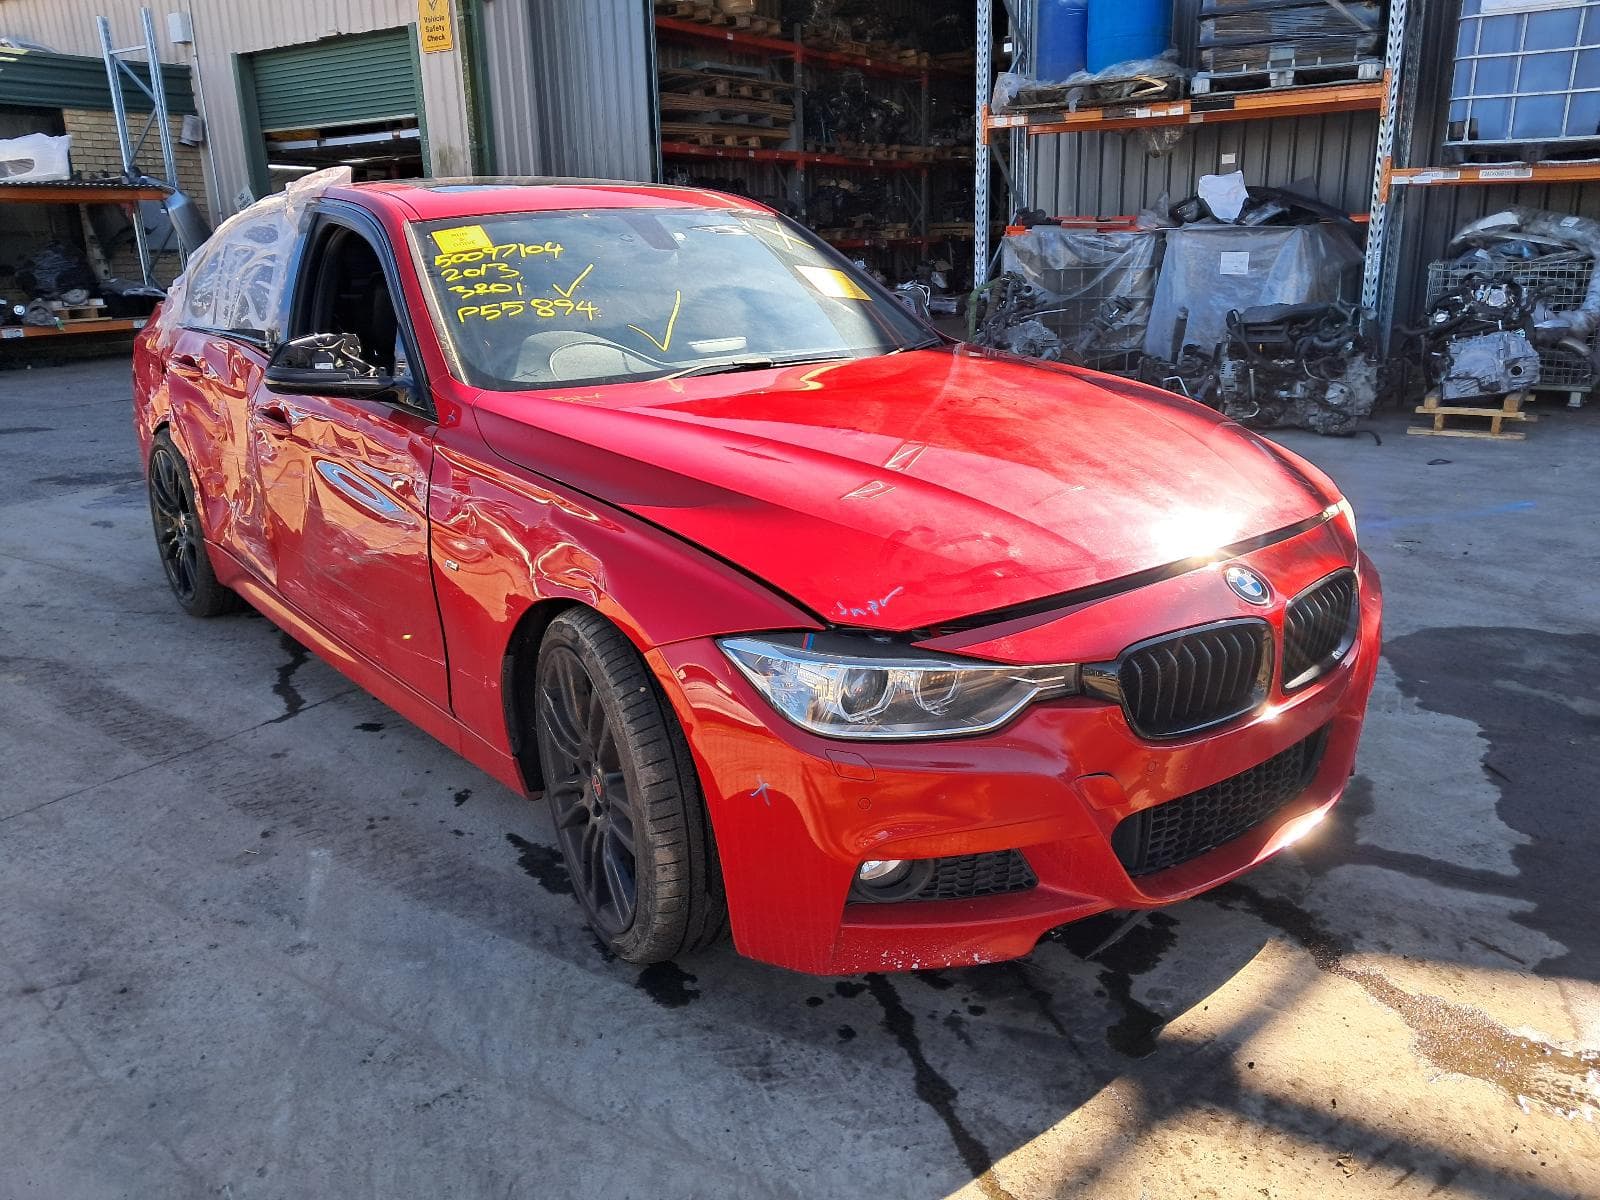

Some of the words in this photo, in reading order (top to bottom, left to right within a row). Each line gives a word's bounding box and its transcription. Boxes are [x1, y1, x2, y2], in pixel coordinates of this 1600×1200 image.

[423, 15, 445, 23] Vehicle
[425, 24, 445, 33] Safety
[426, 34, 446, 42] Check
[434, 241, 564, 268] 50097104
[440, 262, 520, 282] 2013
